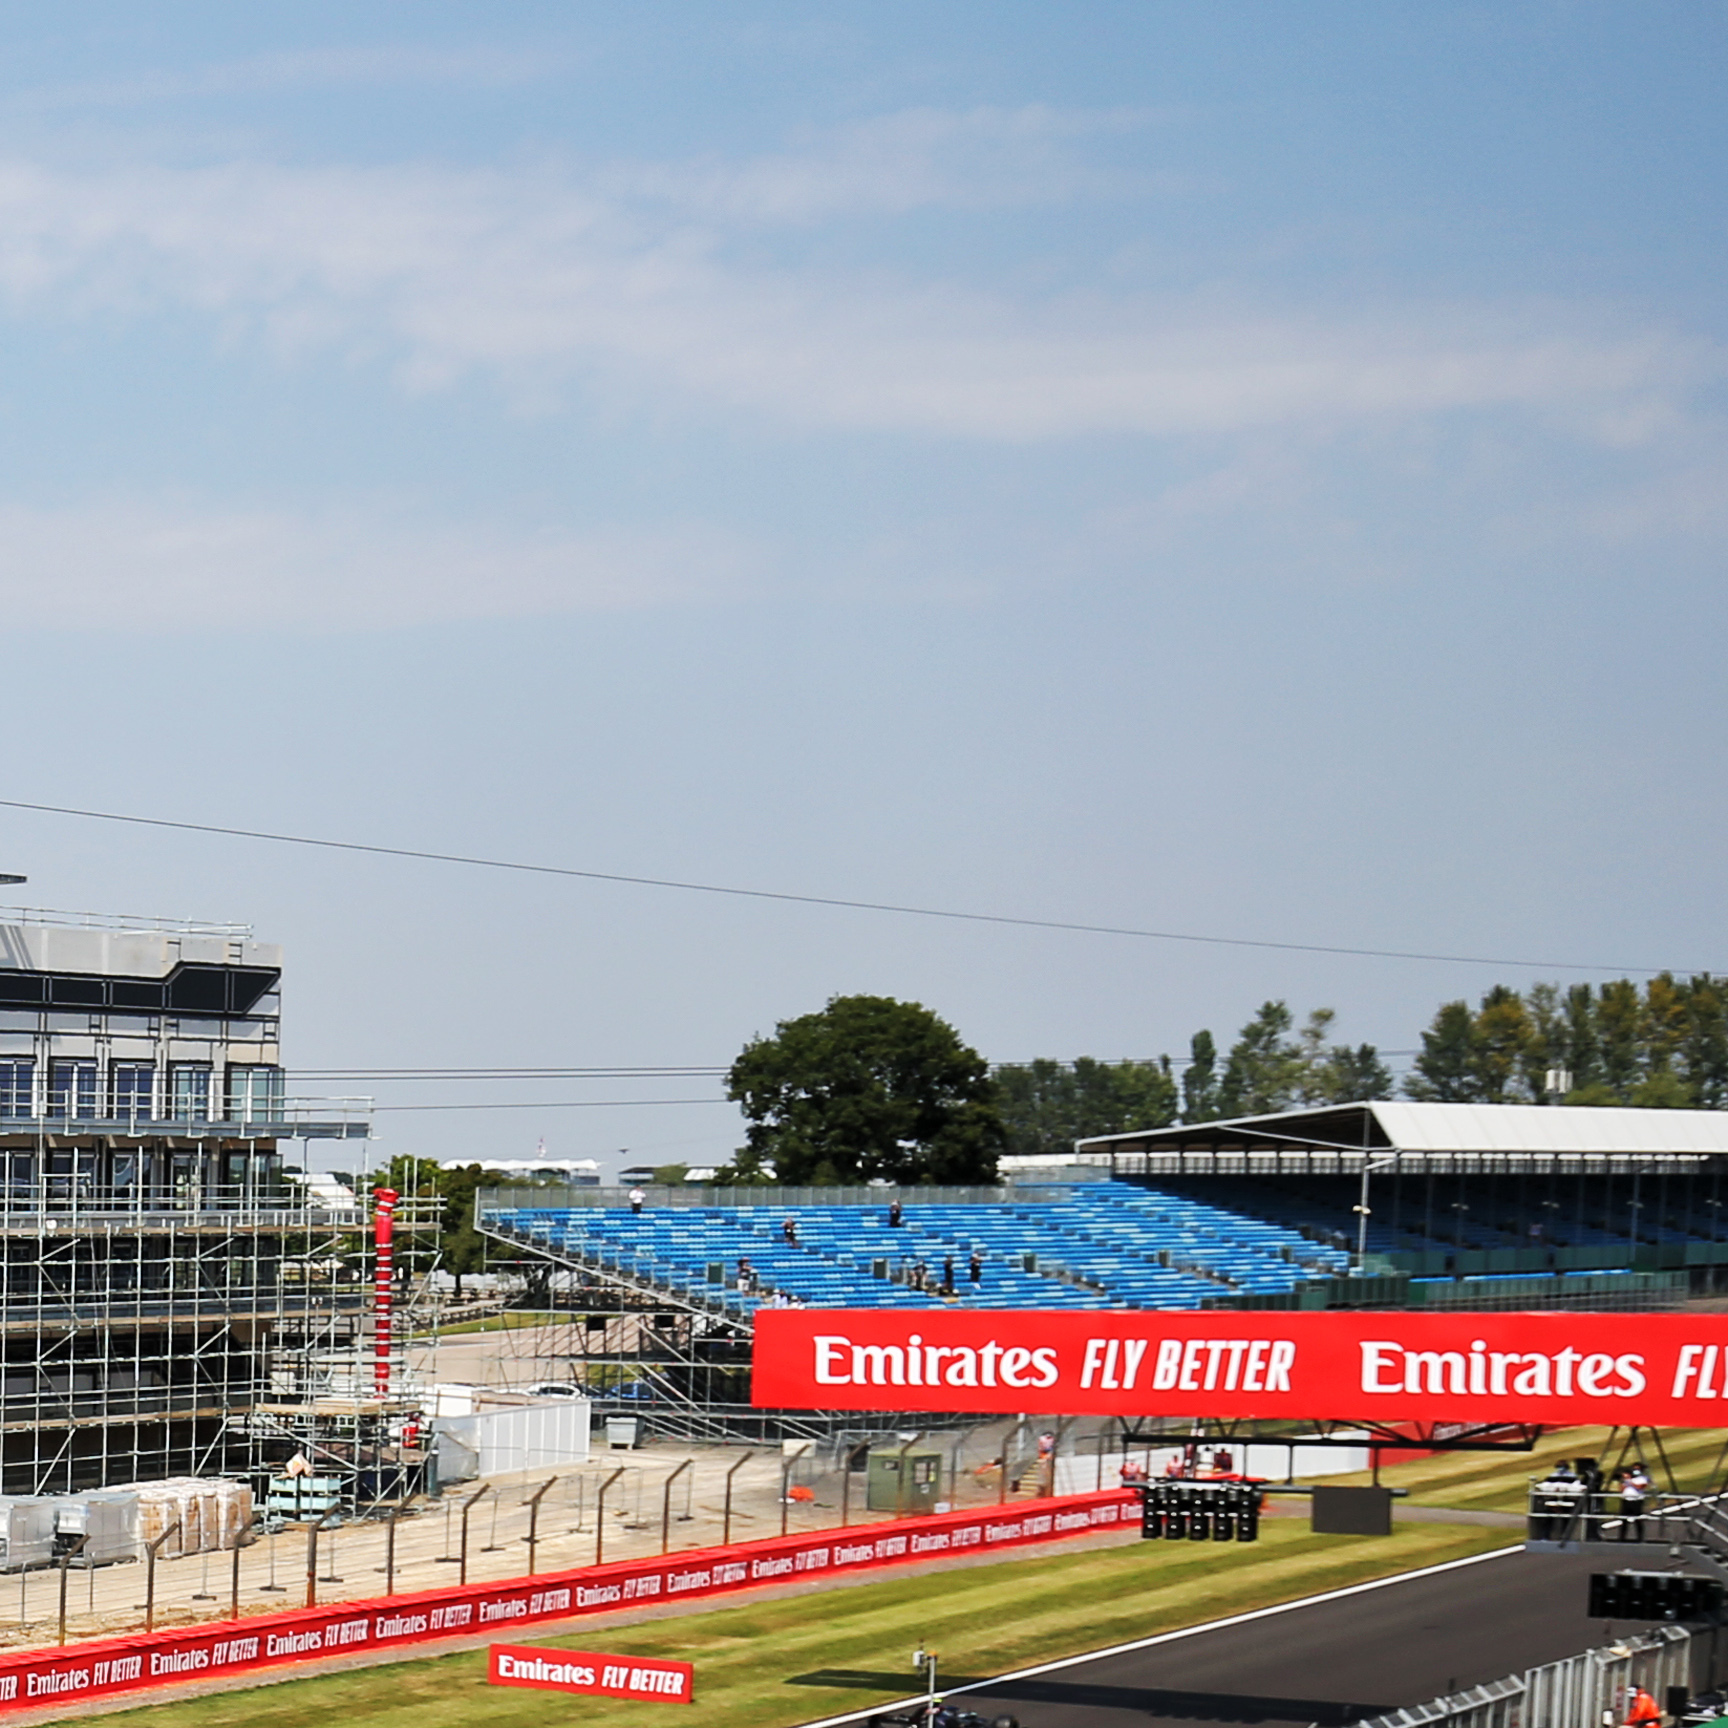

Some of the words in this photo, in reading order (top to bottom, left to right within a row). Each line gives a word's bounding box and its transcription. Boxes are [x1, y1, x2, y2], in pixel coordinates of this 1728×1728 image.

[813, 1334, 1058, 1388] Emirates
[1080, 1339, 1148, 1389] FLY
[1152, 1339, 1295, 1392] BETTER
[1359, 1340, 1646, 1397] Emirates
[1671, 1345, 1728, 1399] FL
[375, 1614, 427, 1639] Emirates
[479, 1598, 527, 1623] Emirates
[150, 1648, 209, 1676] Emirates
[212, 1641, 229, 1666] FLY
[228, 1636, 259, 1663] BETTER
[266, 1630, 322, 1658] Emirates
[324, 1624, 340, 1647] FLY
[339, 1618, 369, 1645] BETTER
[26, 1668, 89, 1697] Emirates
[93, 1661, 110, 1686] FLY
[110, 1655, 142, 1683] BETTER
[498, 1654, 595, 1686] Emirates
[601, 1665, 629, 1689] FLY
[630, 1668, 685, 1695] BETTER
